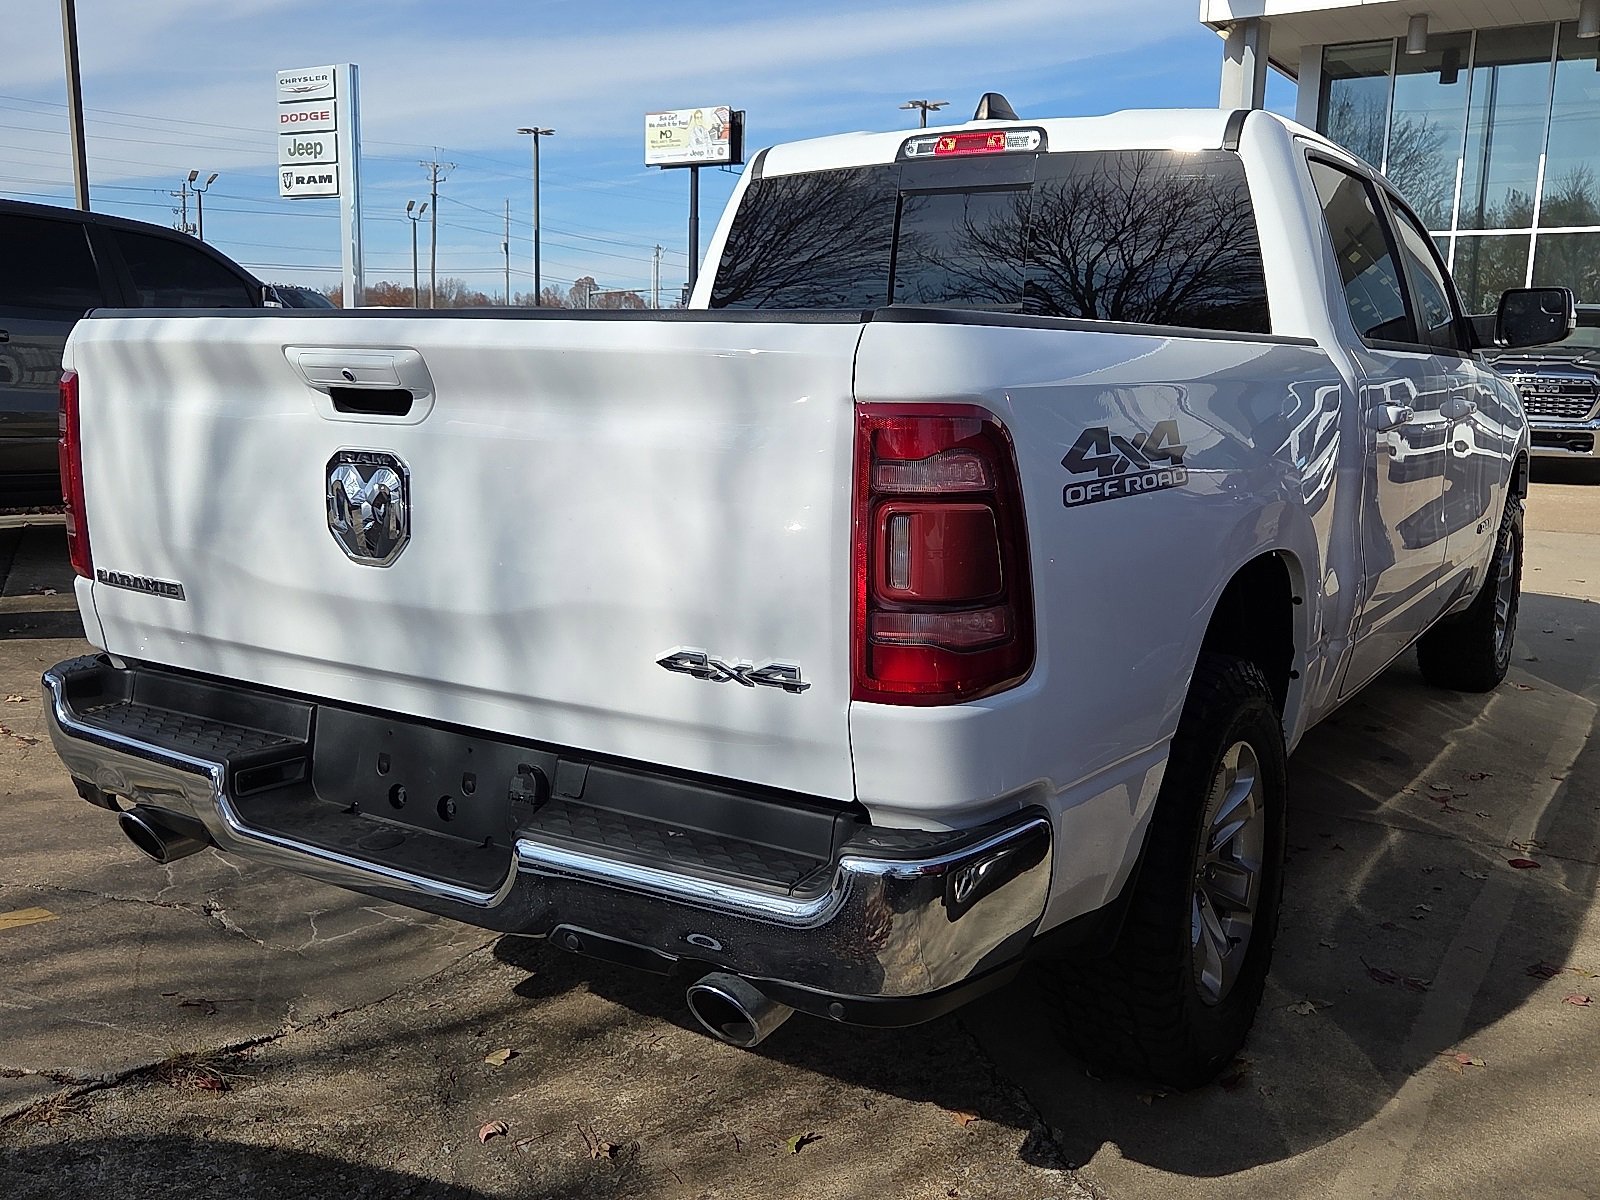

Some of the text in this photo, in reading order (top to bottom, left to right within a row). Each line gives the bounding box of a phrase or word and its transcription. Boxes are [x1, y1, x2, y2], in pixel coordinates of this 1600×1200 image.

[280, 75, 328, 85] CHRYSLER
[280, 111, 330, 123] DODGE
[288, 139, 323, 159] Jeep
[295, 175, 333, 185] RAM
[1065, 469, 1187, 504] OFF ROAD
[96, 568, 186, 601] LARAMIE
